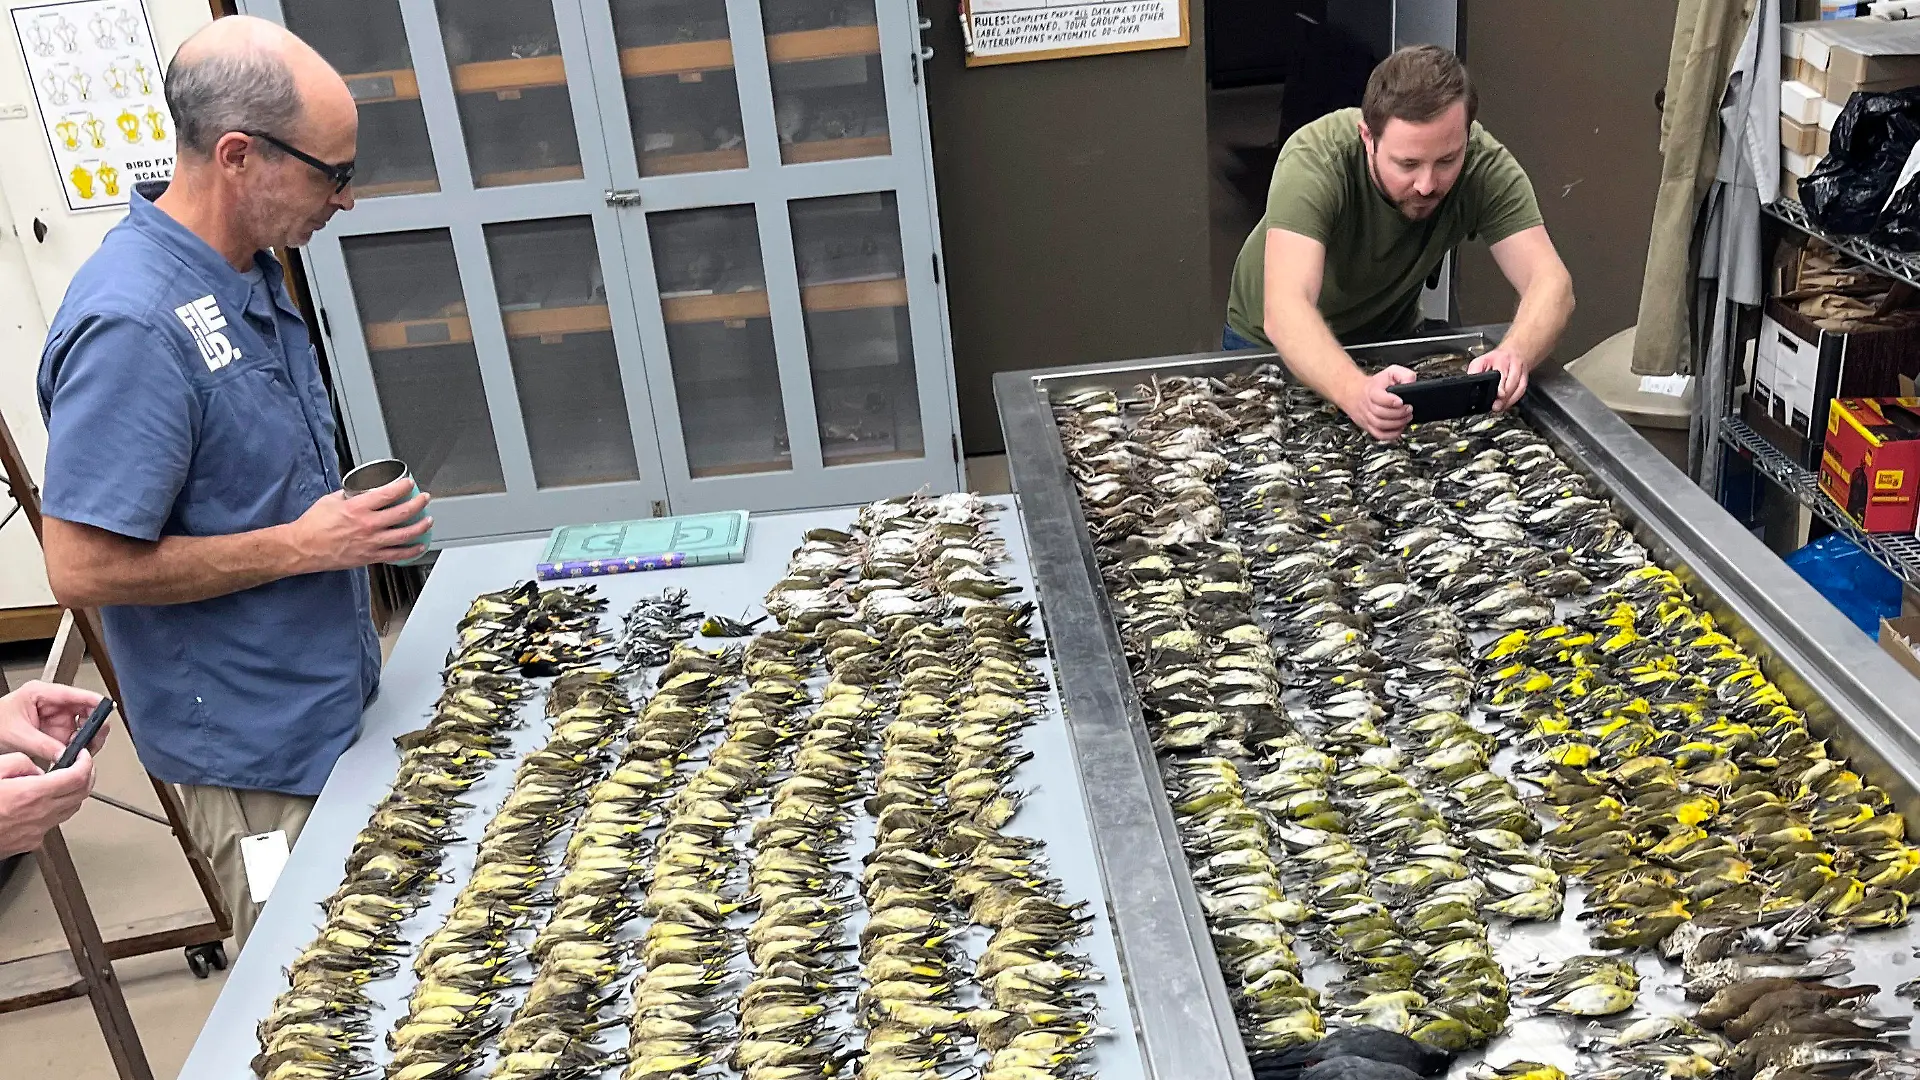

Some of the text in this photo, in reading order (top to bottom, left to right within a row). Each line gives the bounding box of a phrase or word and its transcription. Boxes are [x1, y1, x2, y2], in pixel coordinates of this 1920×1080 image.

[974, 15, 1010, 28] RULES:
[1011, 12, 1048, 24] COMPLETE
[1091, 7, 1110, 17] DATA
[976, 29, 1001, 39] LABEL
[1005, 26, 1021, 36] AND
[1065, 19, 1087, 30] TOUR
[1090, 15, 1120, 28] GROUP
[1120, 14, 1137, 24] AND
[1139, 12, 1164, 23] OTHER
[977, 33, 1046, 49] INTERRUPTIONS
[1052, 28, 1097, 43] AUTOMATIC
[1101, 24, 1140, 36] DO-OVER
[125, 160, 152, 170] BIRD
[134, 169, 172, 181] SCALE
